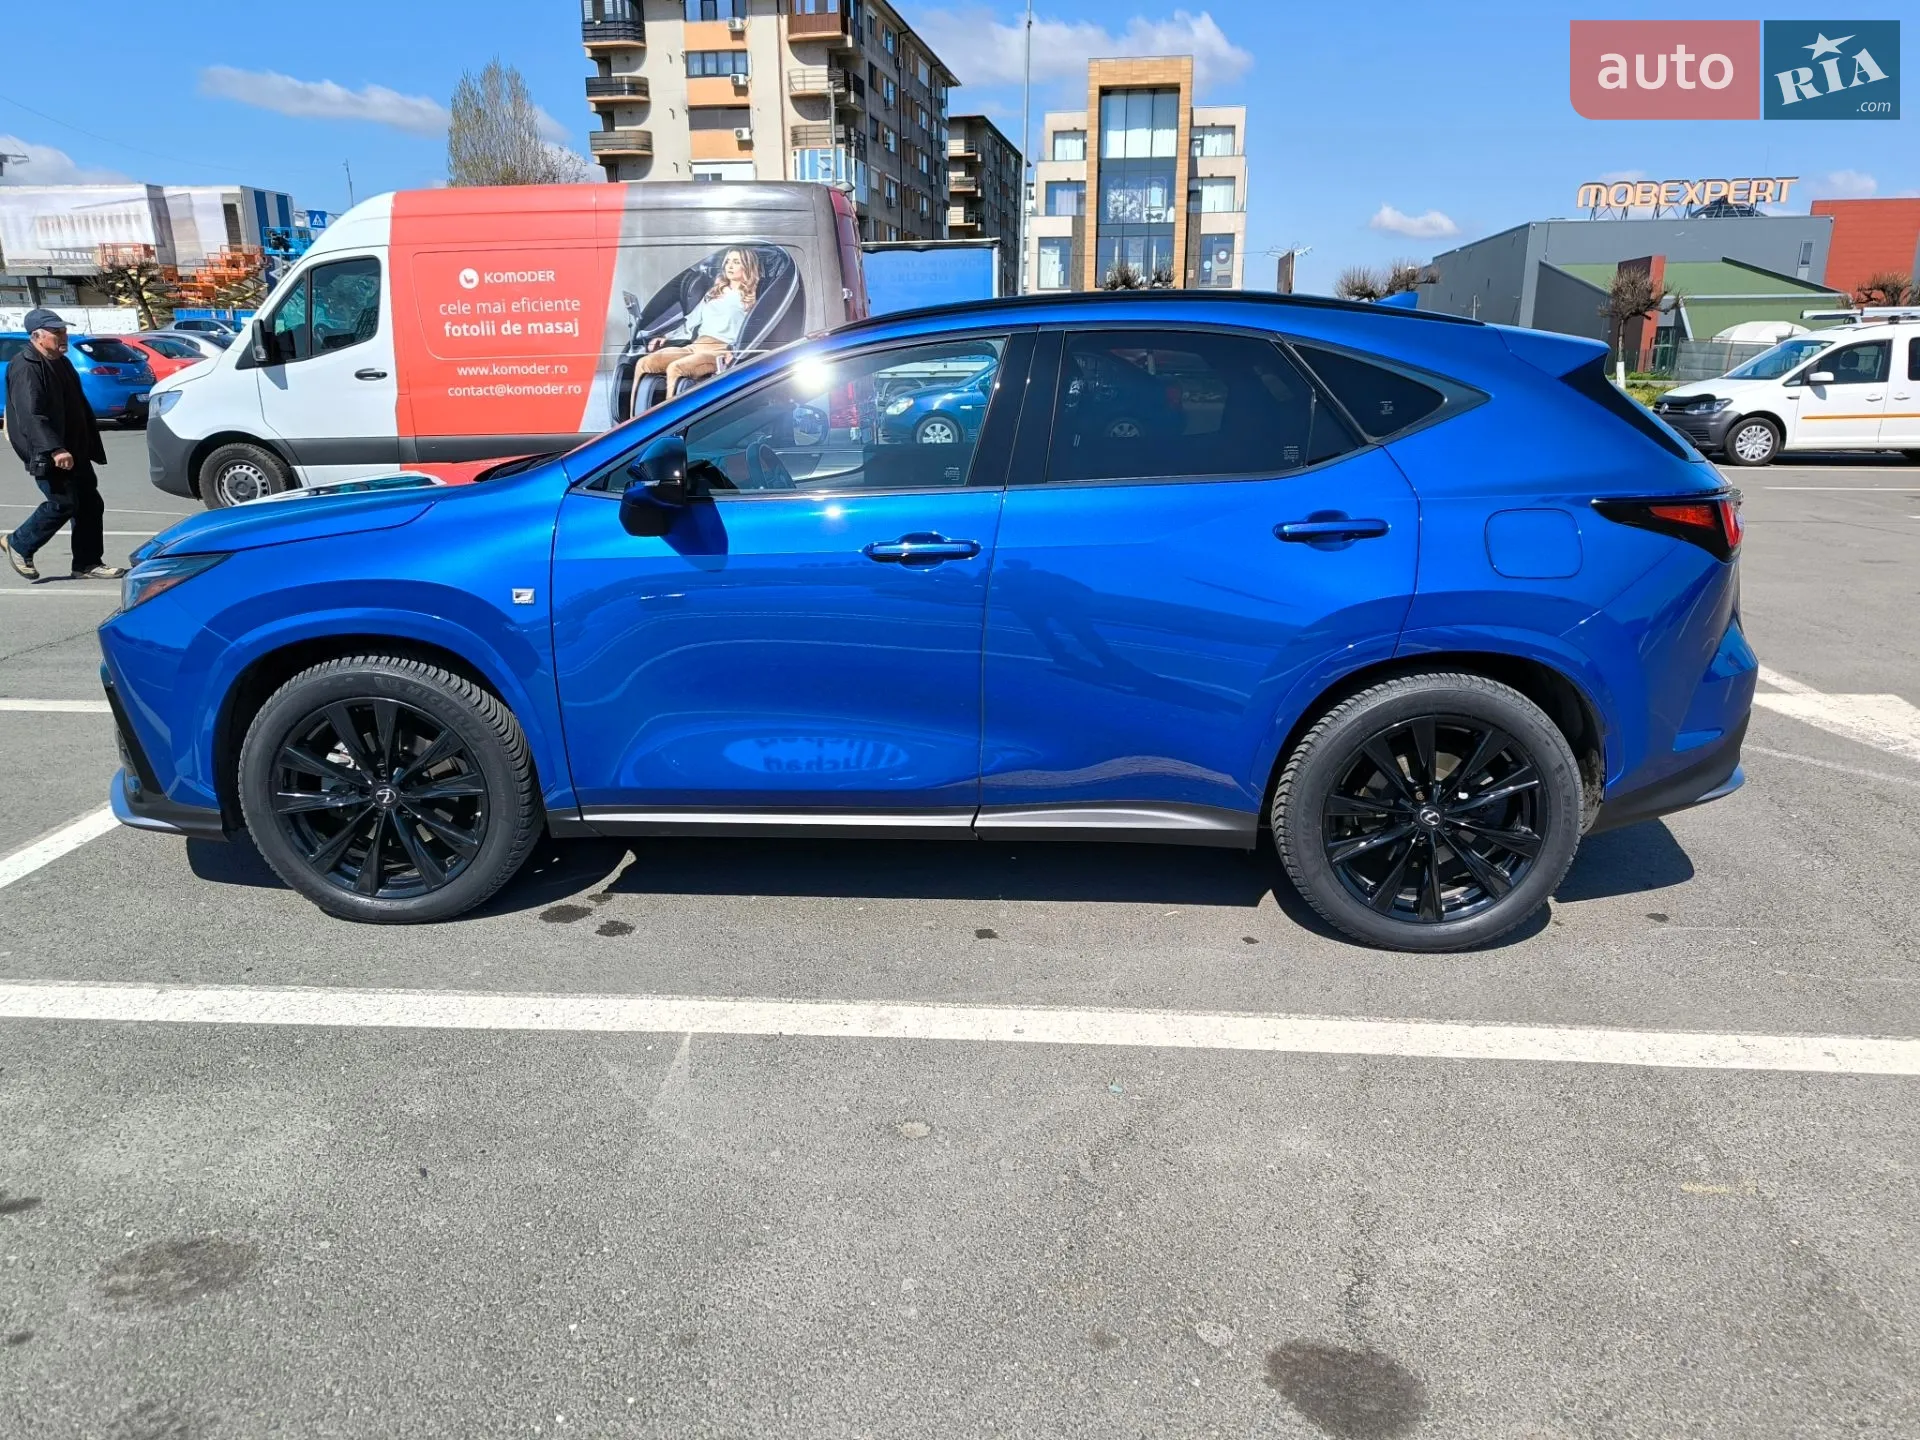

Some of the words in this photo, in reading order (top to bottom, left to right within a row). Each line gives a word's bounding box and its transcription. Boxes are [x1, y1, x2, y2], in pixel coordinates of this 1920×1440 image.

[1576, 177, 1799, 208] MOBEXPERT
[484, 270, 556, 284] KOMODER
[439, 300, 471, 315] cele
[476, 299, 506, 314] mai
[511, 297, 581, 313] eficiente
[444, 320, 496, 337] fotolii
[501, 319, 522, 335] de
[527, 318, 579, 337] masaj
[457, 363, 568, 376] www.komoder.ro
[447, 383, 582, 397] contact@komoder.ro
